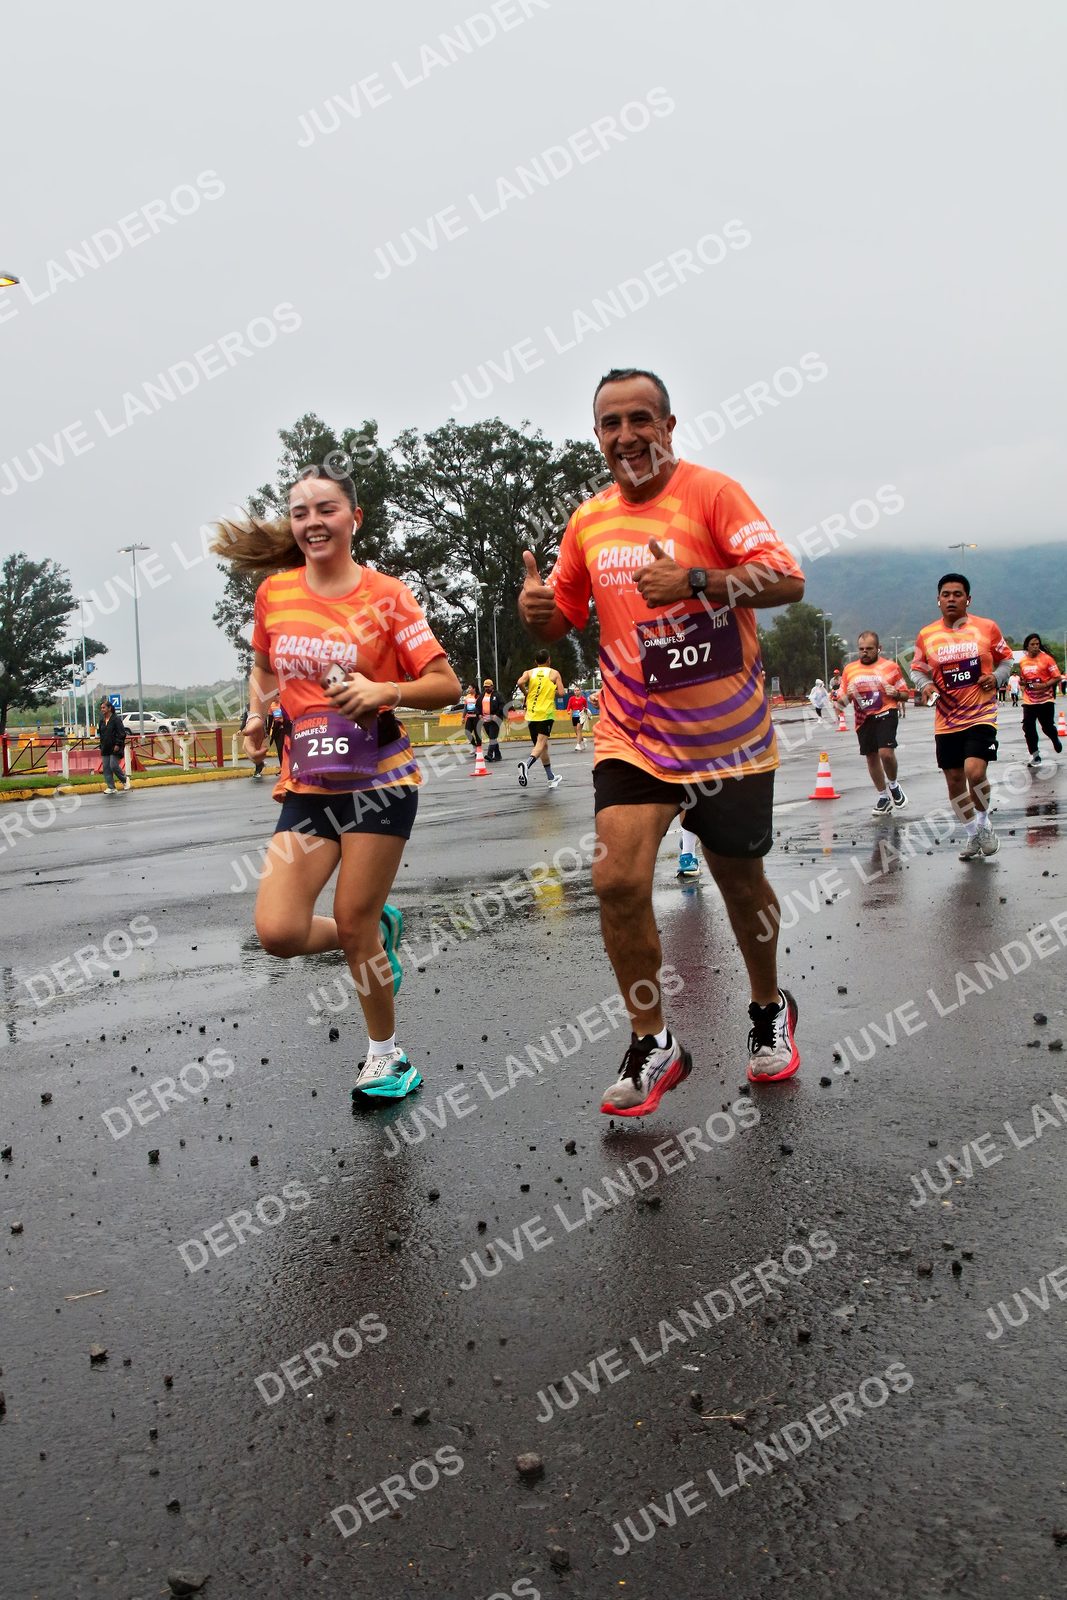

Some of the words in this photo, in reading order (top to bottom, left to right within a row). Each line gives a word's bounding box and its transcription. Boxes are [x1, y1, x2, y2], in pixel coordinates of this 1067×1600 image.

[713, 611, 729, 630] 15K
[275, 634, 358, 664] CARRERA
[667, 642, 711, 669] 207
[952, 671, 971, 683] 768
[294, 717, 328, 733] CARRERA
[307, 737, 349, 757] 256
